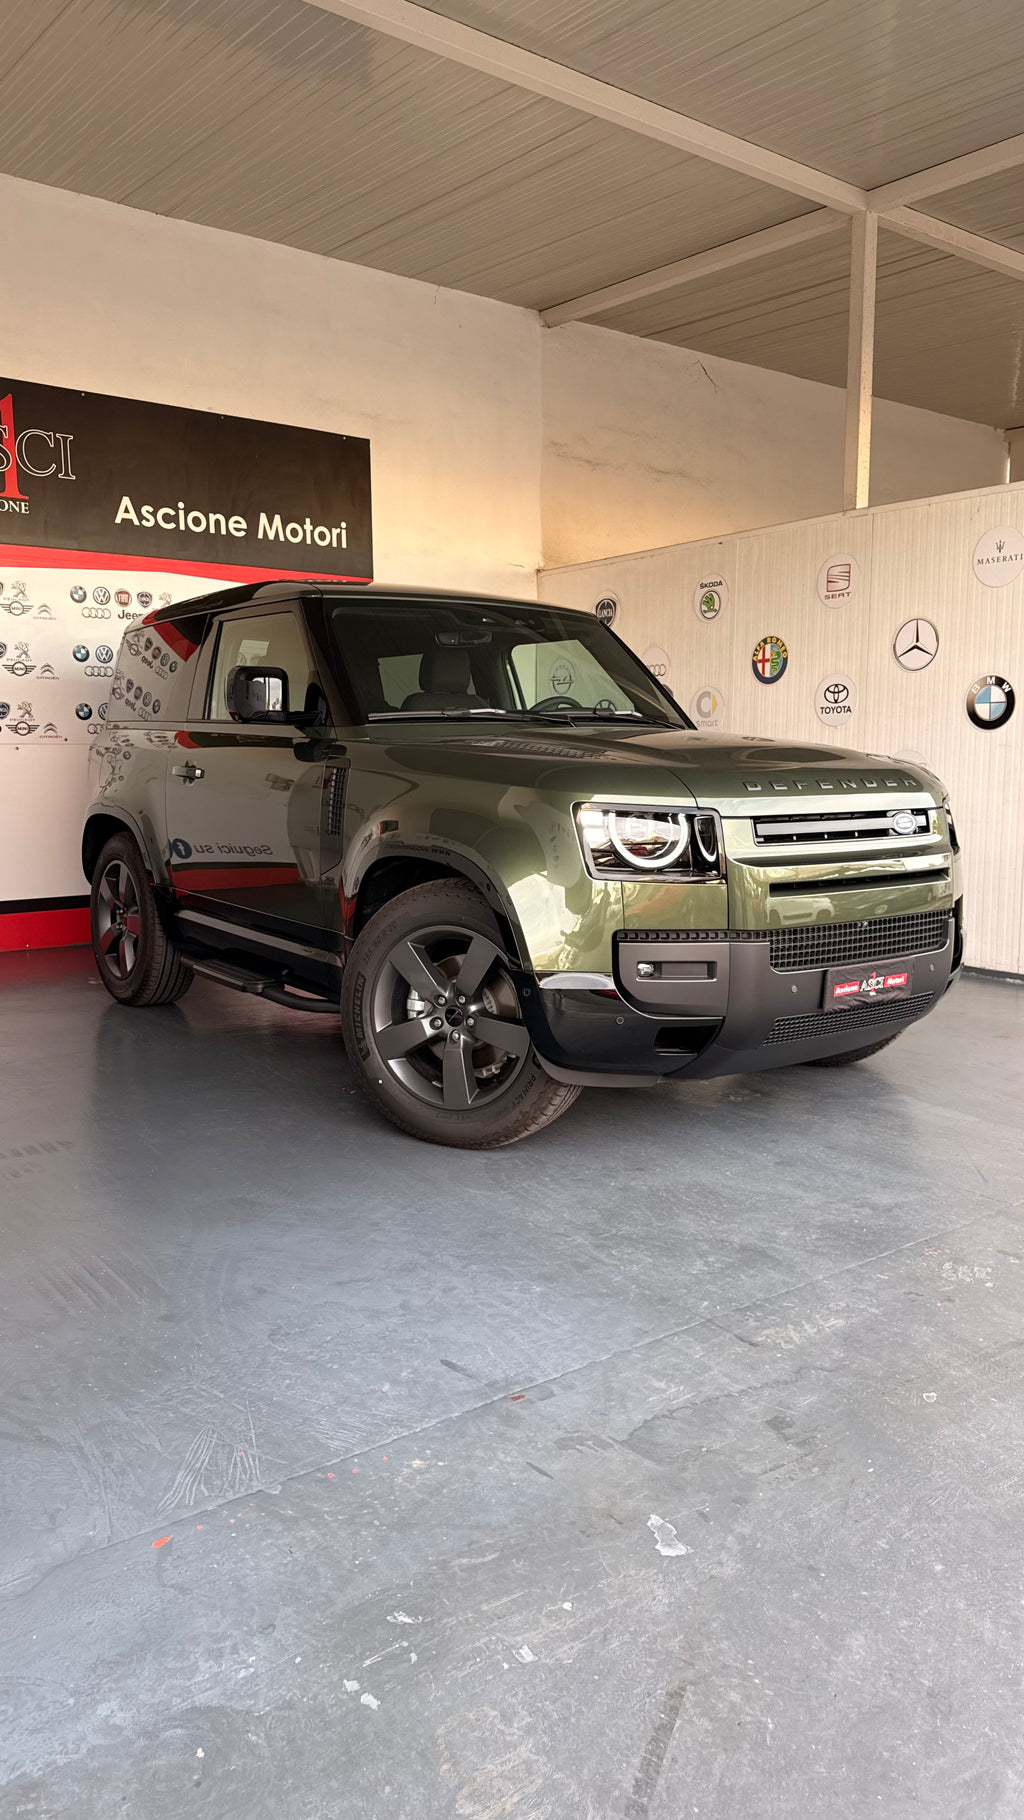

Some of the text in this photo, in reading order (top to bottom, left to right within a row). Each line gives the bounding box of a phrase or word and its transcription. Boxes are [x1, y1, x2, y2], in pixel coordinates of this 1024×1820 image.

[114, 496, 348, 549] Ascione Motori
[976, 553, 1024, 565] MASERATI
[699, 580, 723, 589] ŠKODA
[824, 591, 851, 600] SEAT
[752, 636, 787, 662] ALFA ROMEO
[971, 676, 1012, 694] BMW
[819, 705, 852, 715] TOYOTA
[696, 719, 718, 728] smart
[742, 776, 917, 791] DEFENDER
[353, 974, 366, 1038] MICHELIN
